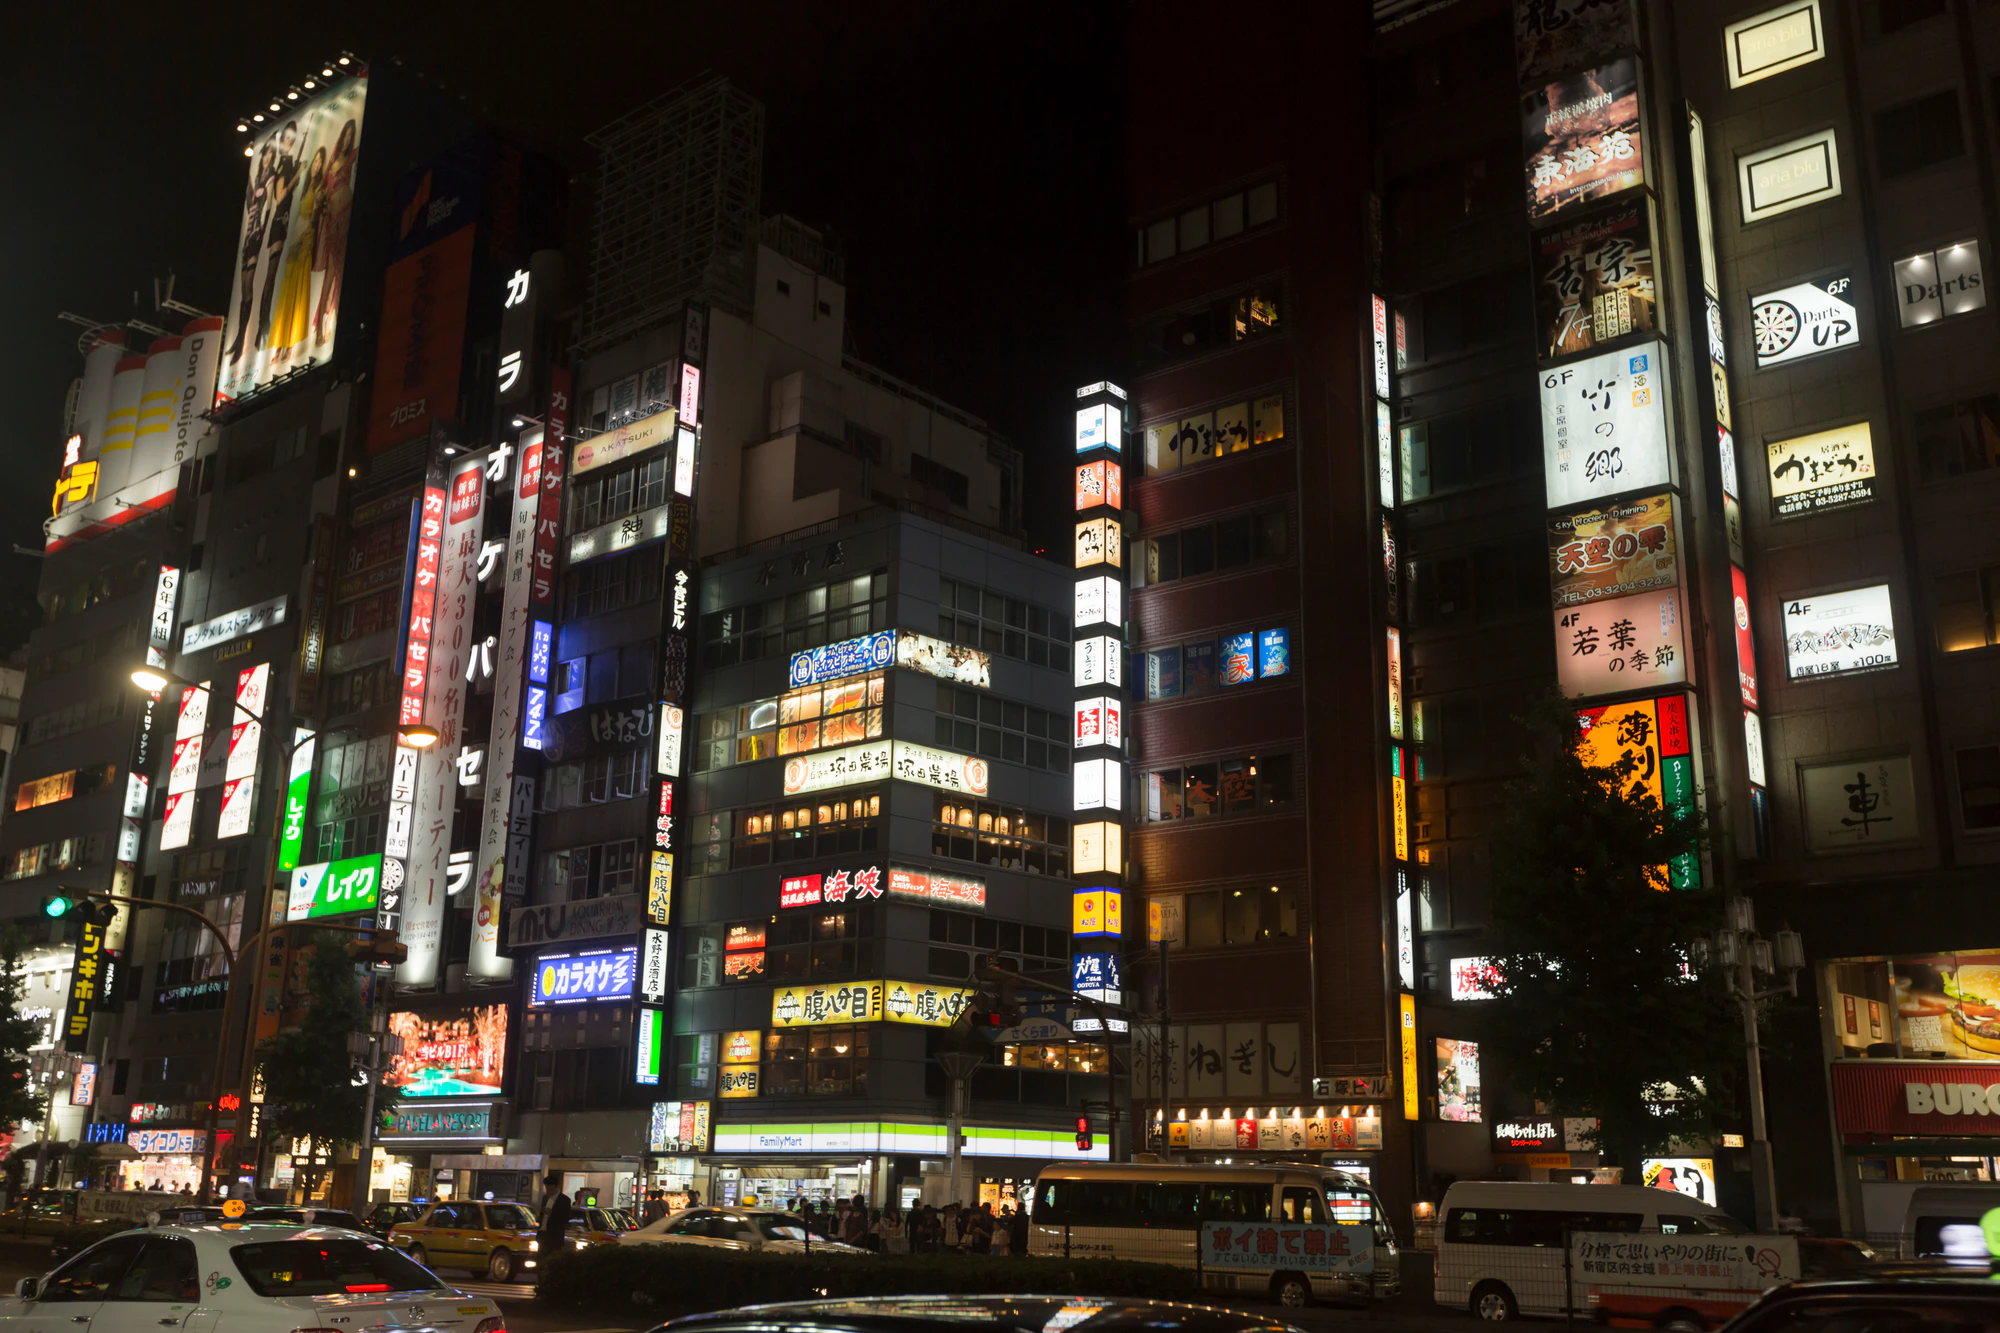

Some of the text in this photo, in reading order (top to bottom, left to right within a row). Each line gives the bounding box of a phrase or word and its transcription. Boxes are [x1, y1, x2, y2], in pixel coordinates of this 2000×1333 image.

[1545, 92, 1613, 126] 正統派焼肉
[1534, 131, 1635, 188] 東海苑
[1569, 168, 1638, 195] International Menu
[1759, 160, 1819, 189] aria blu
[1548, 239, 1637, 298] 吉宗
[1827, 278, 1850, 295] 6F
[1904, 271, 1981, 306] Darts
[1558, 303, 1591, 346] 7F
[1803, 306, 1840, 325] Darts
[1812, 319, 1852, 347] UP
[1545, 369, 1573, 389] 6F
[174, 339, 205, 463] Don Quijote
[389, 398, 427, 429] プロミス
[600, 428, 652, 455] AKATSUKI
[1769, 443, 1787, 456] 5F
[1773, 453, 1864, 483] かまどか
[457, 477, 478, 496] 新宿
[534, 391, 568, 598] カラオケパセラ
[452, 494, 480, 514] 姉妹店
[1778, 501, 1811, 515] 電話番号
[1815, 488, 1872, 506] 03-5287-5594
[1574, 513, 1609, 527] Modern
[1556, 525, 1667, 573] 天空の雫
[1655, 558, 1673, 571] 5F
[407, 493, 442, 685] カラオケパセラ
[671, 570, 689, 630] 今宮ビル
[153, 576, 176, 641] 6年4組
[1561, 613, 1580, 628] 4F
[1787, 602, 1811, 616] 4F
[185, 606, 284, 647] エンタメレストランタワー
[1572, 619, 1637, 656] 若葉
[1609, 645, 1675, 672] の季節
[240, 673, 250, 685] 9F
[183, 690, 192, 702] 8F
[527, 687, 547, 738] 747
[591, 703, 654, 743] はなび
[1666, 702, 1682, 750] 炭火串焼
[175, 743, 185, 755] 4F
[166, 797, 177, 811] B1
[225, 784, 235, 798] 2F
[1841, 772, 1894, 837] 車
[286, 797, 303, 841] レイク
[513, 782, 532, 868] パーティー
[656, 815, 674, 848] 海峡
[326, 866, 375, 903] レイク
[649, 874, 669, 923] 腹八分目
[823, 866, 884, 903] 海峡
[930, 876, 984, 906] 海峡
[479, 906, 492, 922] 名物
[571, 902, 624, 921] AQUARIUM
[569, 917, 603, 936] DINING
[270, 940, 284, 970] 麻雀
[646, 932, 663, 993] 水野屋酒店
[724, 956, 764, 976] 海峡
[555, 959, 612, 995] カラオケ
[611, 956, 631, 994] 747
[801, 986, 869, 1023] 腹八分目
[871, 985, 881, 1017] 2F
[914, 987, 973, 1022] 腹八分
[639, 1014, 651, 1069] FamilyMart
[1011, 1025, 1058, 1040] さくら通り
[1910, 1024, 1942, 1035] FRESHLY
[1911, 1038, 1945, 1050] FOR YOU
[1189, 1039, 1298, 1078] ねぎし
[720, 1071, 757, 1092] 腹八分目
[1316, 1080, 1387, 1097] 石塚ビル
[131, 1106, 142, 1120] 4F
[398, 1112, 443, 1133] PASELA
[760, 1136, 802, 1149] FamilyMart
[1495, 1122, 1558, 1139] 長崎ちゃんぽん
[1701, 1163, 1711, 1171] B1
[1212, 1228, 1351, 1256] ポイ捨て禁止
[1579, 1241, 1745, 1263] 分煙で思いやりの街に。
[1213, 1253, 1337, 1267] すてない心できれいなまちに
[1348, 1251, 1369, 1267] 新宿区
[1583, 1260, 1734, 1278] 新宿区内全域 路上喫煙禁止
